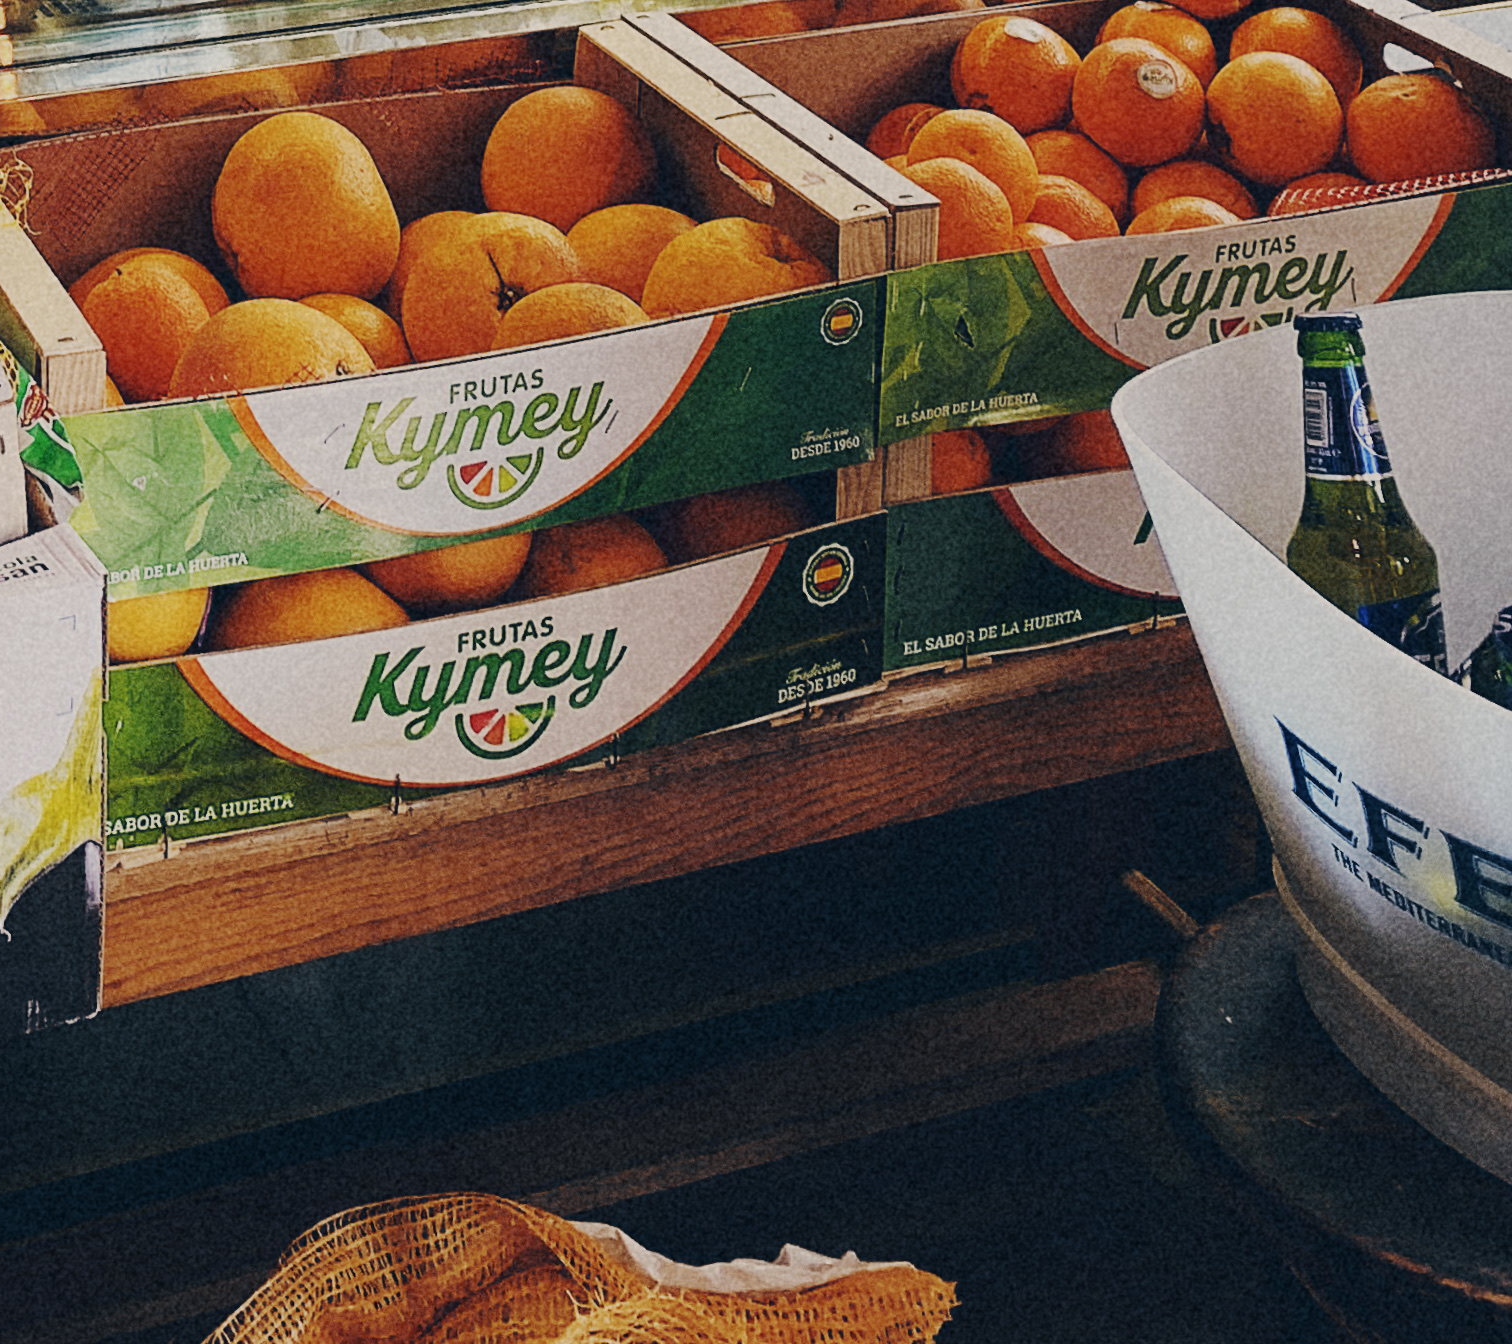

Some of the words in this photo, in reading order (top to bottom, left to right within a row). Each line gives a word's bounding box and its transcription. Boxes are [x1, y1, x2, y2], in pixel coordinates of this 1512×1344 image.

[1215, 234, 1297, 263] FRUTAS
[1121, 249, 1354, 340] Kymey
[449, 368, 544, 405] FRUTAS
[895, 414, 909, 427] EL
[911, 405, 950, 424] SABOR
[952, 401, 968, 415] DE
[970, 399, 986, 412] LA
[989, 392, 1038, 409] HUERTA
[344, 381, 614, 491] Kymey
[791, 441, 832, 461] DESDE
[833, 435, 861, 452] 1960
[108, 564, 141, 585] BOR
[143, 564, 164, 580] DE
[166, 562, 186, 577] LA
[188, 552, 249, 574] HUERTA
[458, 616, 554, 653] FRUTAS
[903, 640, 922, 656] EL
[925, 630, 975, 652] SABOR
[978, 625, 997, 642] DE
[1001, 621, 1020, 637] LA
[1023, 609, 1083, 633] HUERTA
[351, 627, 628, 741] Kymey
[778, 678, 824, 704] DESDE
[826, 668, 857, 690] 1960
[165, 809, 190, 828] DE
[194, 806, 217, 822] LA
[221, 794, 294, 819] HUERTA
[1273, 714, 1512, 931] EFE
[1331, 843, 1364, 883] THE
